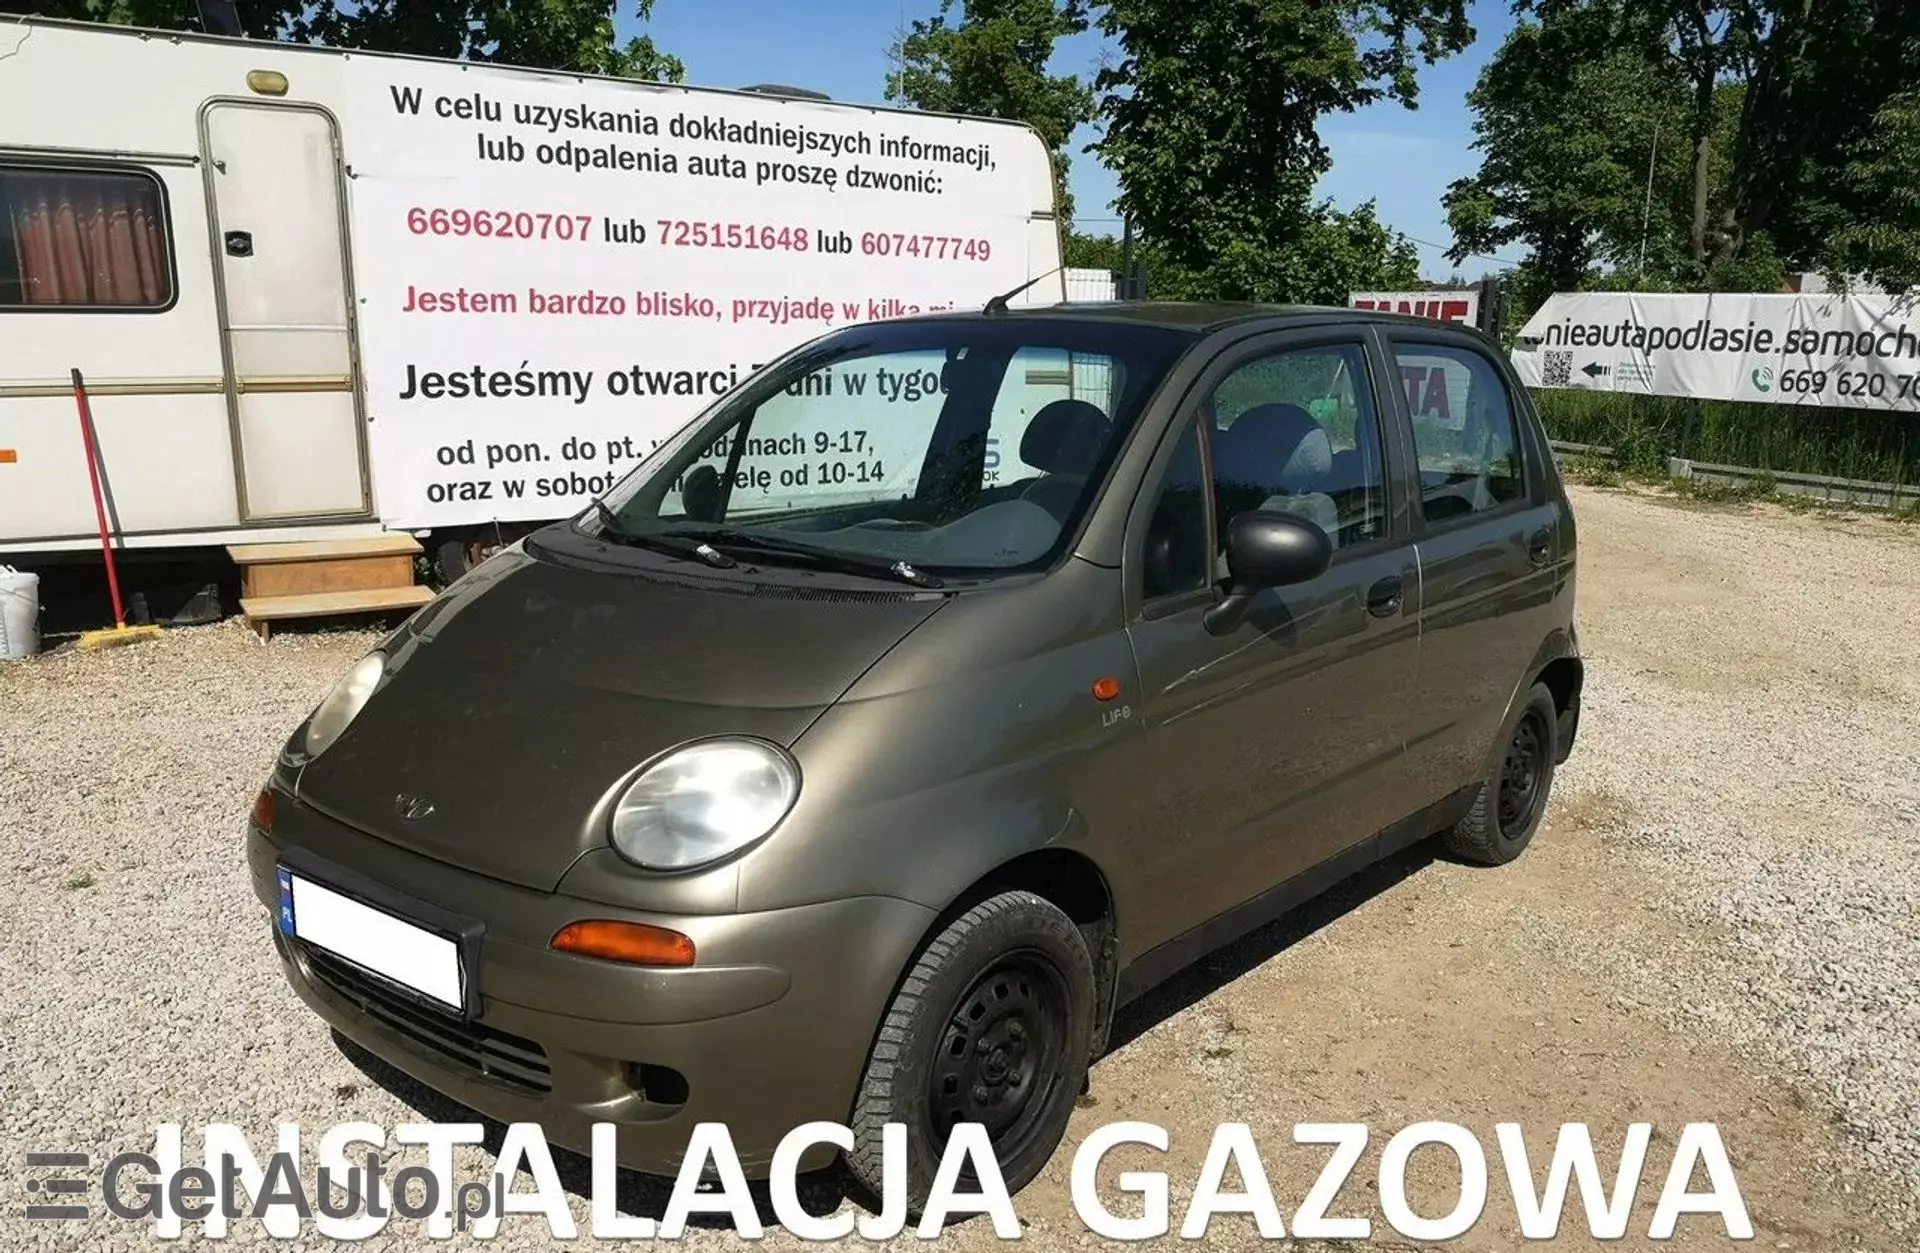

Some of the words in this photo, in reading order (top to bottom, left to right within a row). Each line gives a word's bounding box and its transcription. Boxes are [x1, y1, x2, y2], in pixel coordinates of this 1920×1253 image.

[390, 85, 423, 115] W
[434, 93, 501, 122] celu
[513, 103, 659, 136] uzyskania
[669, 112, 872, 157] dokładniejszych
[879, 133, 997, 172] informacji,
[477, 133, 525, 163] lub
[536, 140, 678, 173] odpalenia
[687, 155, 747, 180] auta
[756, 160, 838, 192] proszę
[845, 165, 943, 194] dzwonić:
[407, 207, 593, 242] 669620707
[603, 217, 646, 244] lub
[657, 219, 809, 252] 725151648
[817, 229, 853, 255] lub
[861, 231, 991, 262] 607477749
[402, 286, 517, 314] Jestem
[528, 288, 626, 315] bardzo
[636, 291, 722, 321] blisko,
[732, 296, 835, 326] przyjadę
[843, 301, 860, 320] w
[399, 361, 593, 404] Jesteśmy
[607, 364, 737, 396] otwarci
[843, 371, 867, 396] w
[1780, 369, 1828, 394] 669
[1837, 372, 1886, 397] 620
[437, 440, 474, 466] od
[487, 442, 551, 469] pon.
[562, 436, 596, 461] do
[606, 436, 643, 463] pt.
[814, 430, 874, 456] 9-17,
[427, 480, 492, 503] oraz
[503, 479, 525, 498] w
[536, 470, 623, 497] sobot
[780, 463, 808, 487] od
[818, 460, 884, 485] 10-14
